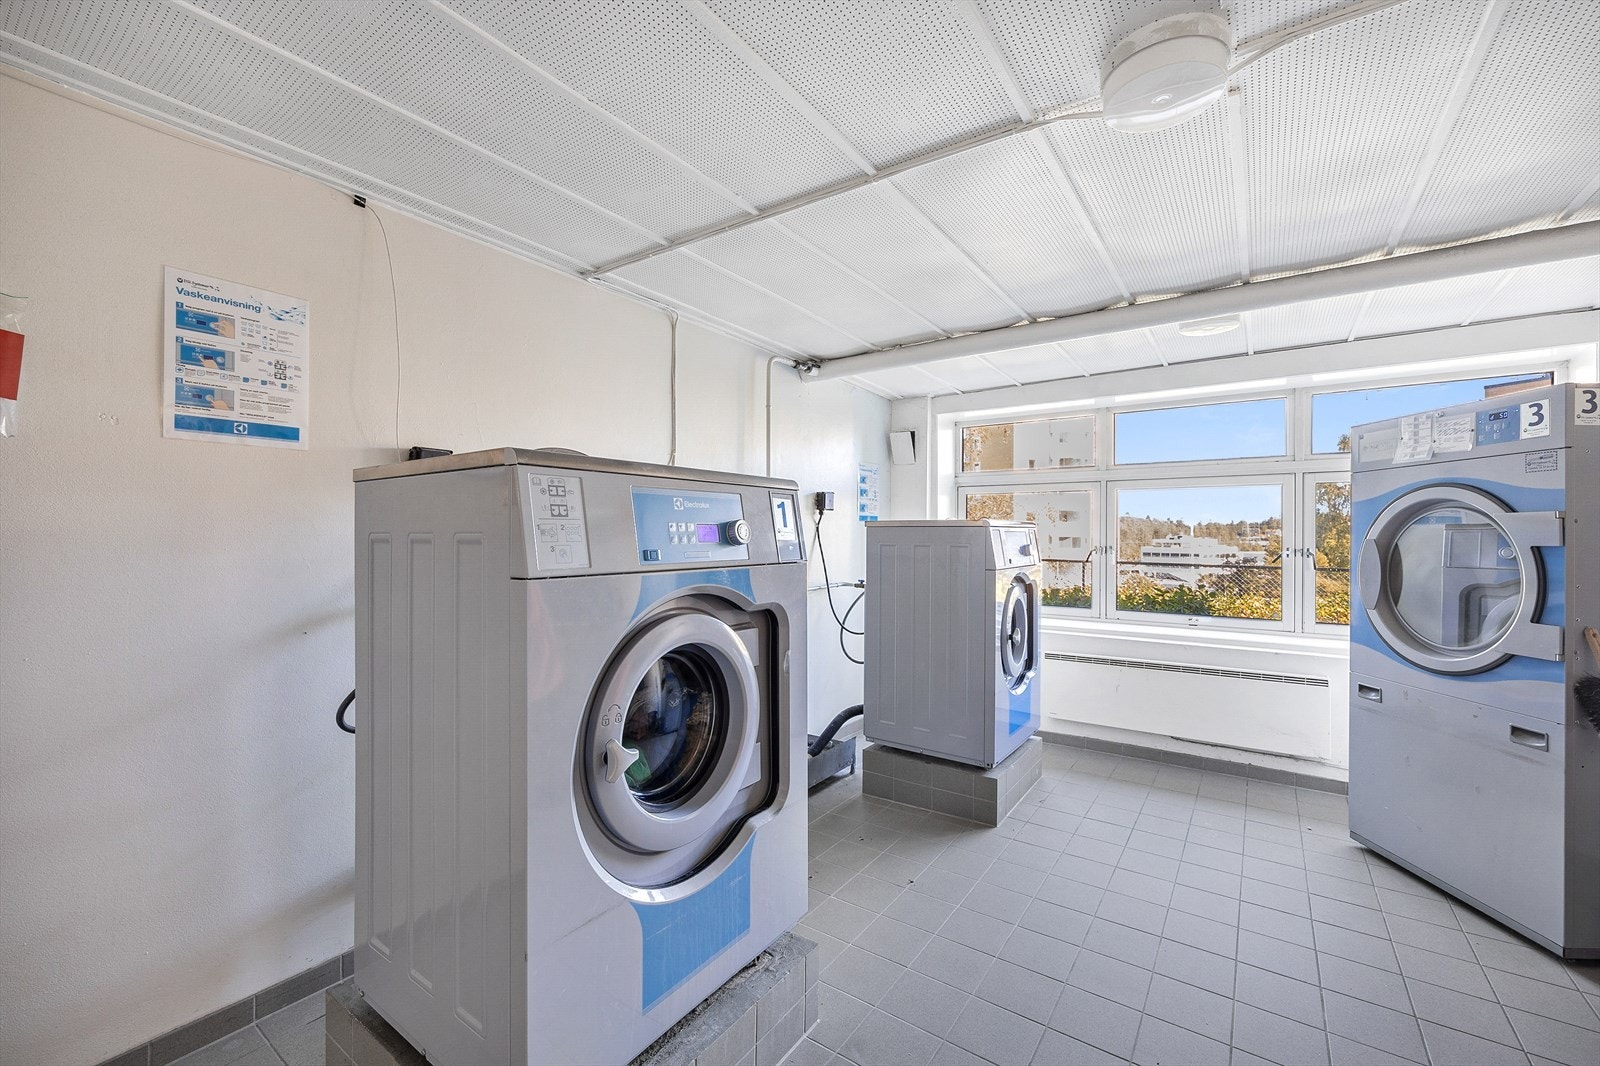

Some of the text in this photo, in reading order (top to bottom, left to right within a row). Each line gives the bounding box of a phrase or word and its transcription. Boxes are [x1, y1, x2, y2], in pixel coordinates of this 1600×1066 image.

[175, 286, 261, 313] Vaskeanvisning
[1528, 402, 1545, 426] 3
[1581, 389, 1598, 414] 3
[684, 501, 710, 509] Electrolux
[776, 501, 788, 528] 1
